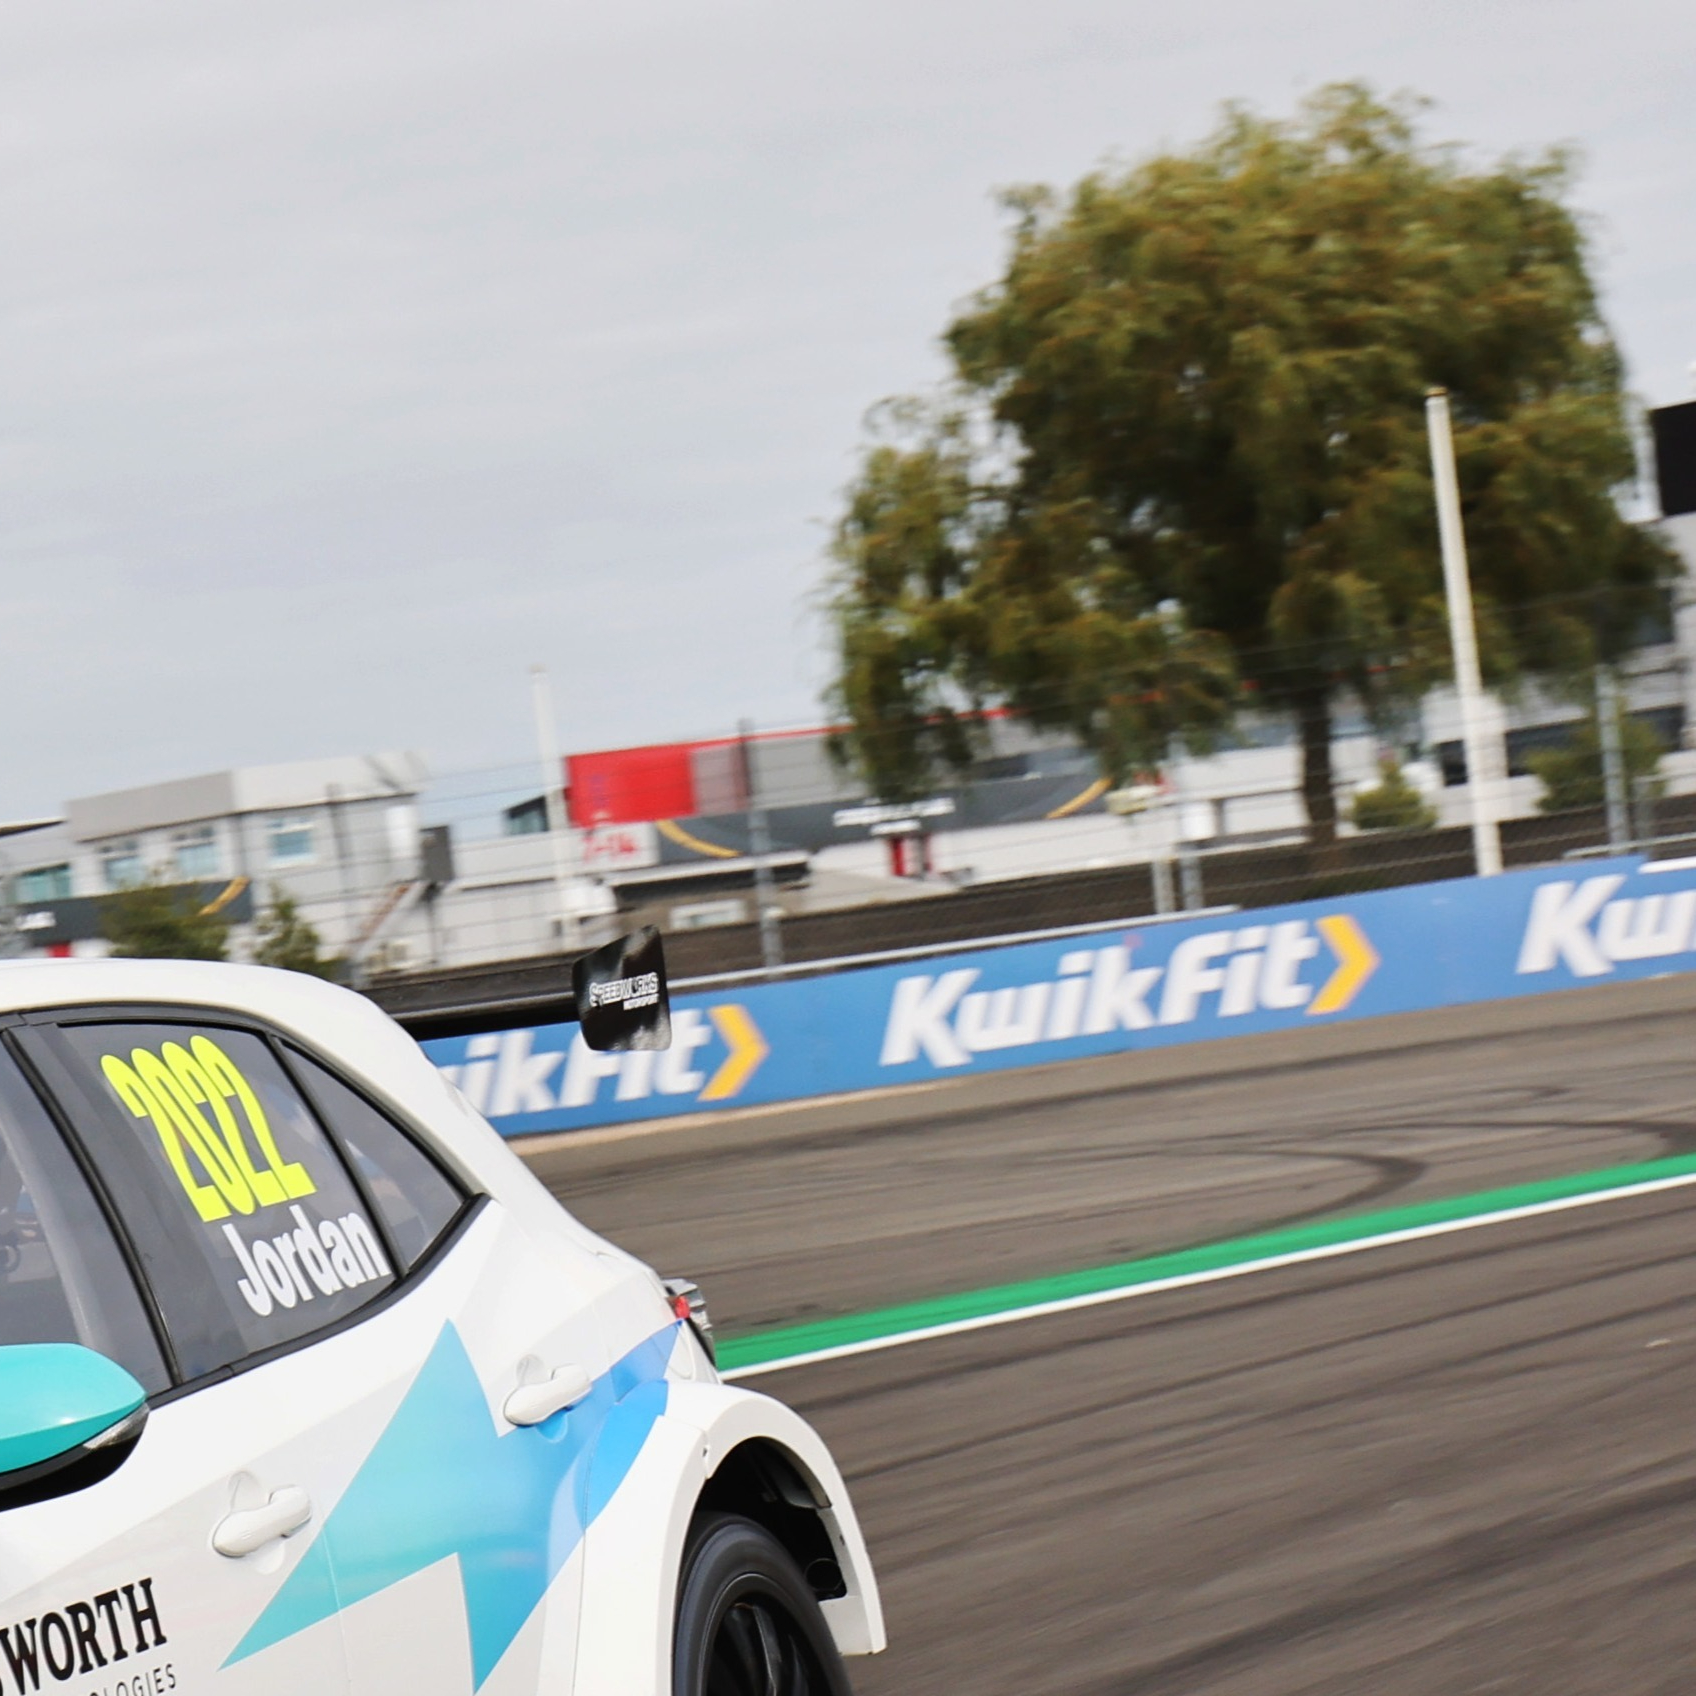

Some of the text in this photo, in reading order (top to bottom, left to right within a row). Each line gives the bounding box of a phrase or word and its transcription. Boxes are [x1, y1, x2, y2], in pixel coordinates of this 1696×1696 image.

[1516, 873, 1696, 978] Kw
[100, 1035, 318, 1223] 2022
[221, 1204, 393, 1317] Jordan
